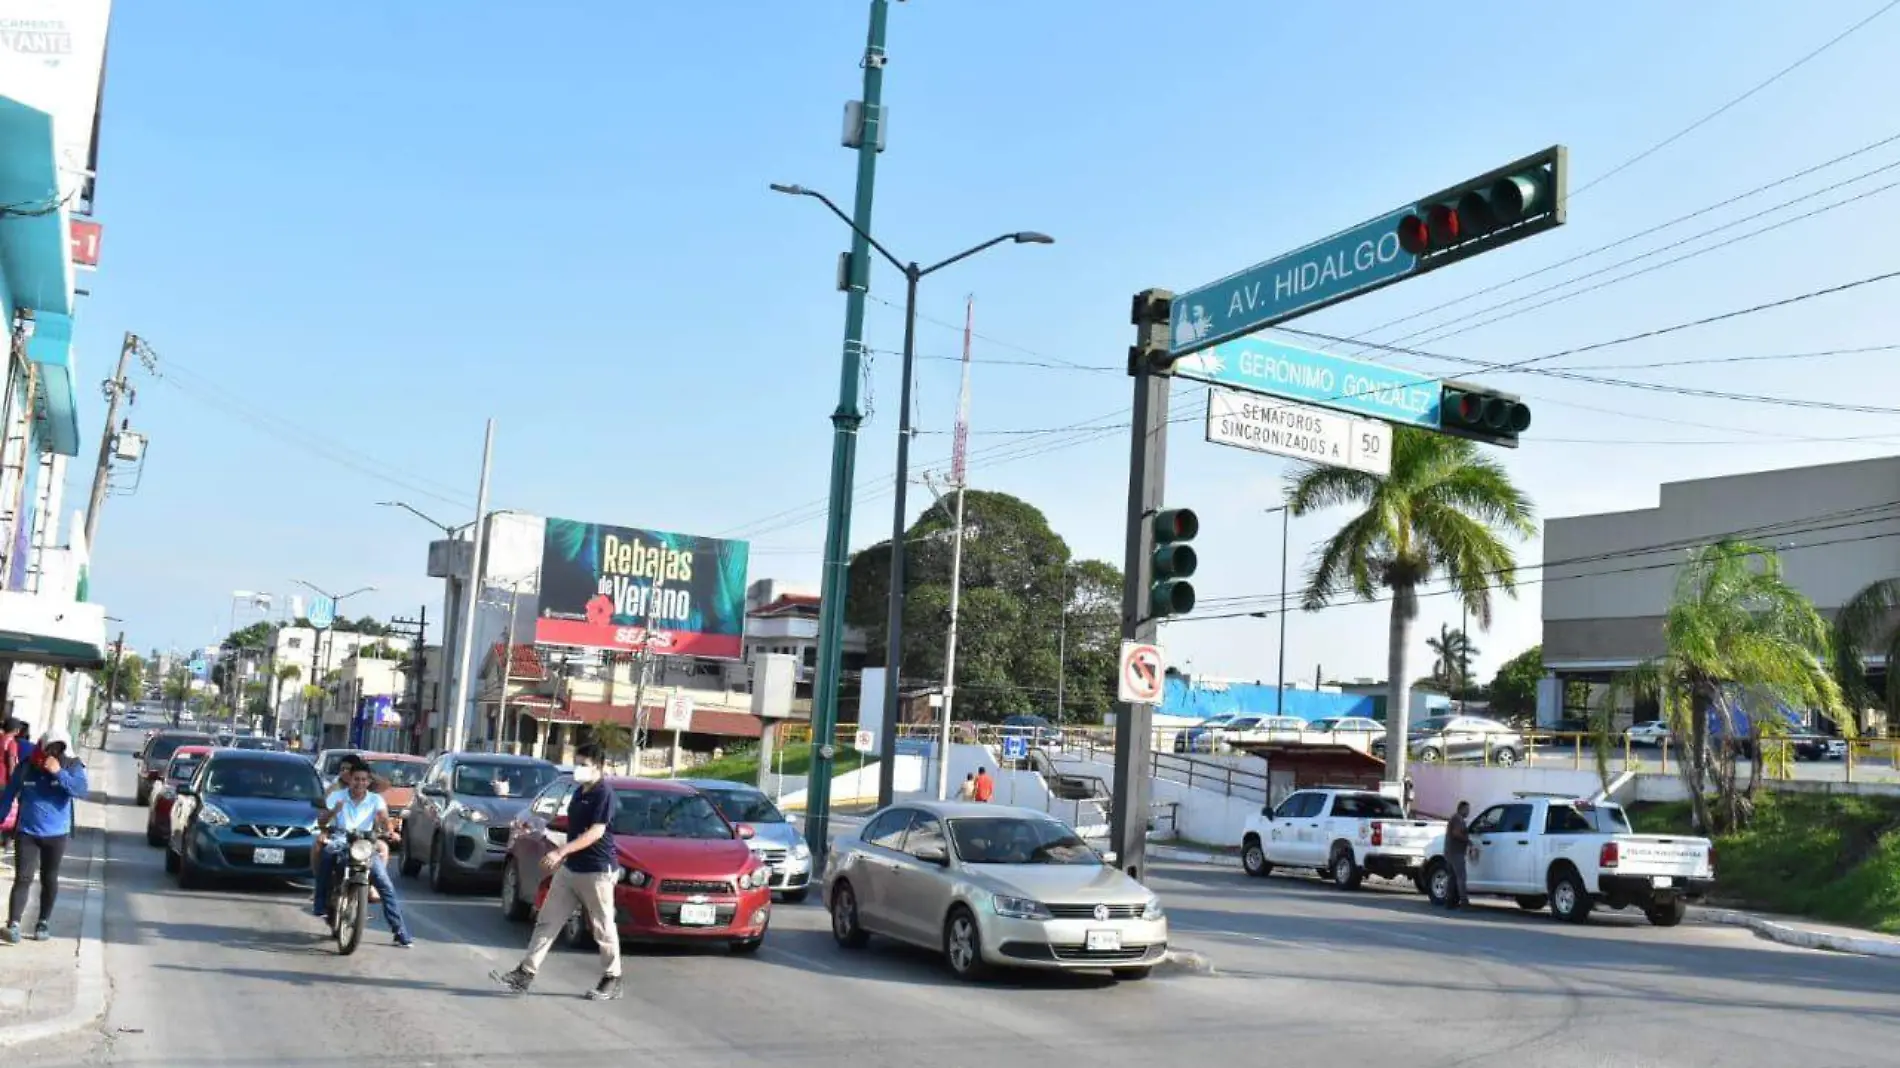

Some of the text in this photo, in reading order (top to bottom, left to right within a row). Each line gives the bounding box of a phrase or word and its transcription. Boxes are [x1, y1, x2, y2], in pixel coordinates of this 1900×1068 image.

[1227, 231, 1400, 318] AV. HIDALGO
[1238, 350, 1335, 392] GERÓNIMO
[1221, 419, 1341, 458] SINCRONIZADOS A
[1242, 403, 1323, 434] SEMAFOROS
[1361, 432, 1380, 453] 50
[603, 534, 694, 585] Rebajas
[598, 575, 613, 595] de
[613, 575, 690, 621] Verano
